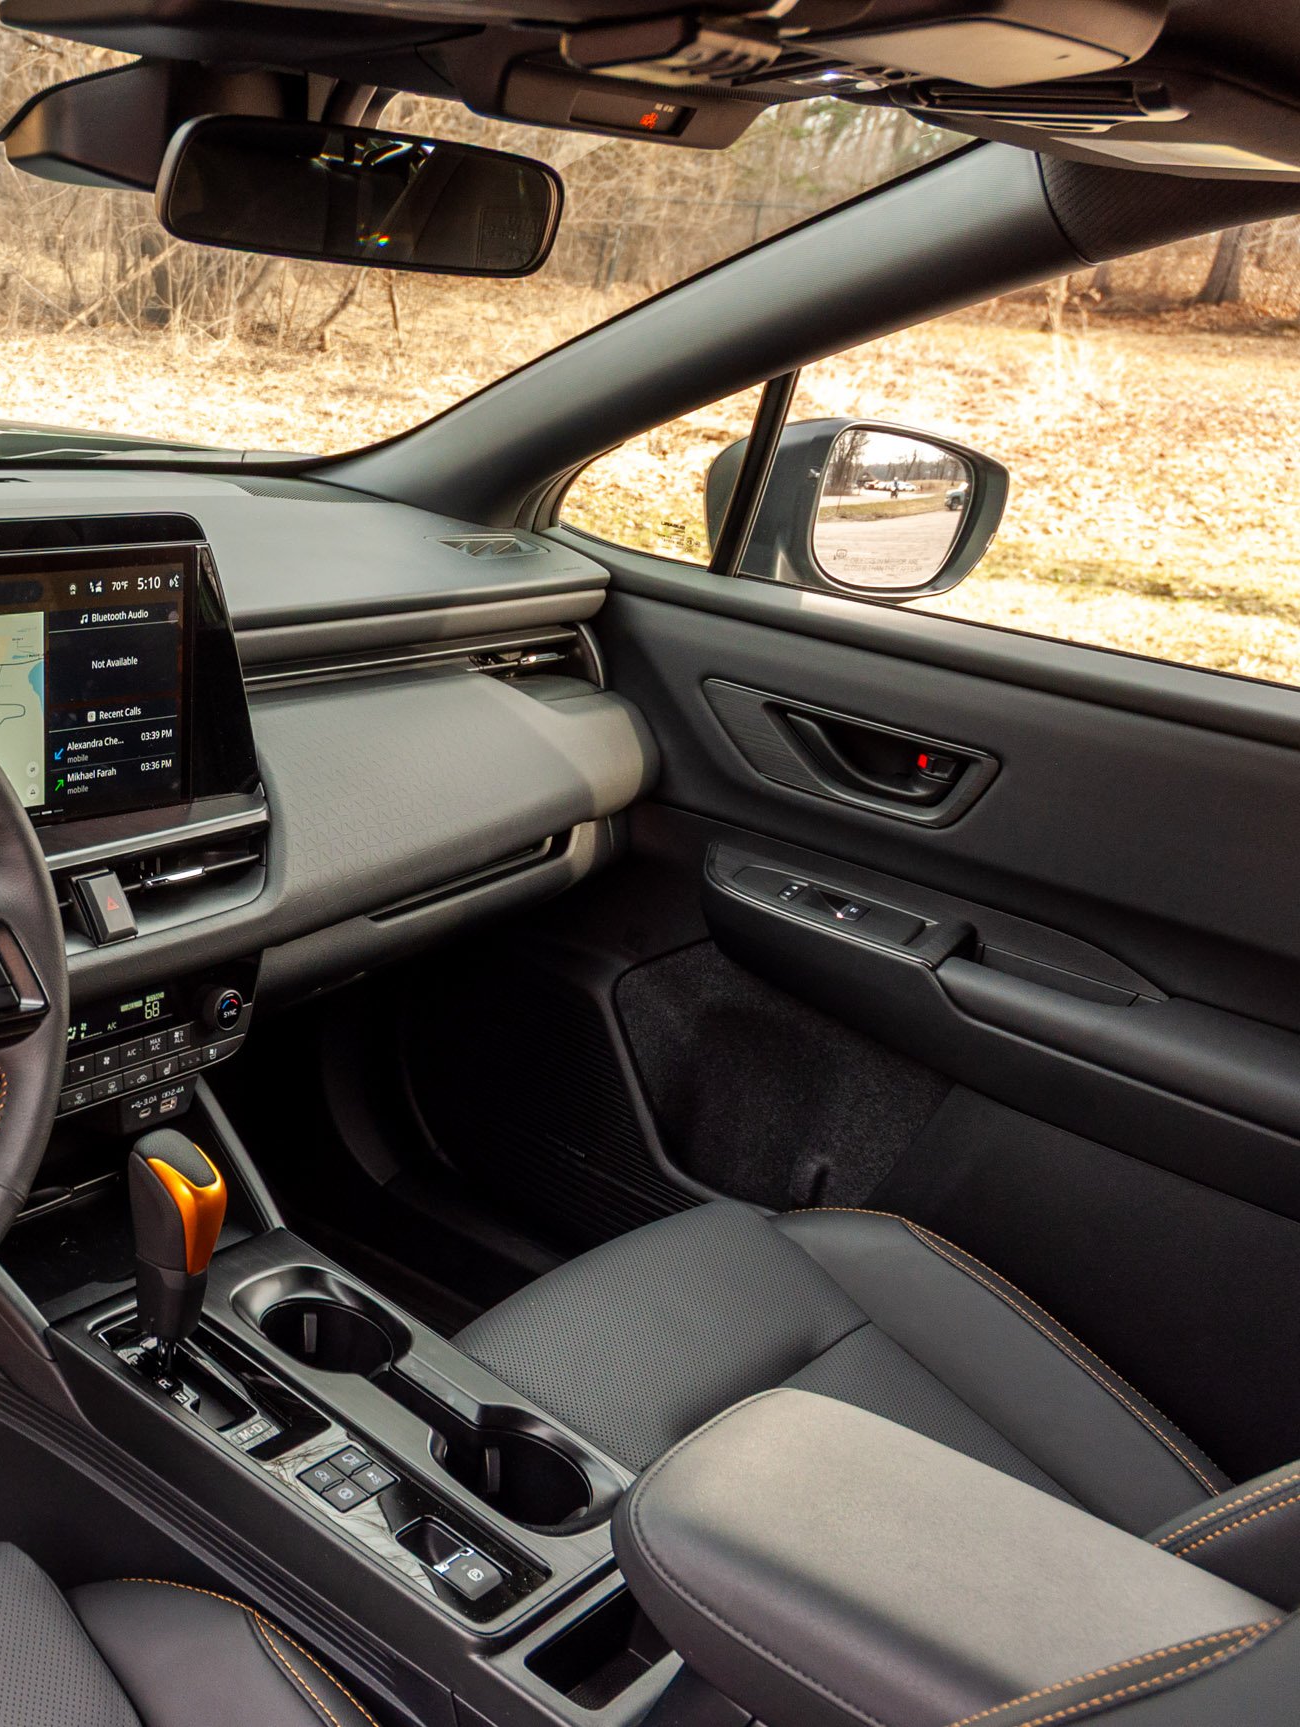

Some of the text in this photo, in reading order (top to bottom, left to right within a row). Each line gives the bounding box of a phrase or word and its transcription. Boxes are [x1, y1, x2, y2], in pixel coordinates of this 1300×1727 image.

[137, 576, 161, 590] 5:10
[92, 610, 148, 622] Bluetooth Audio
[92, 656, 138, 670] Not Available
[100, 706, 142, 720] Recent Calls
[140, 729, 172, 741] 03:39 PM
[66, 738, 102, 751] Alexandra
[67, 754, 88, 764] mobile
[140, 758, 172, 772] 03:36 PM
[67, 767, 116, 782] Mikhael Farah
[67, 785, 88, 795] mobile
[144, 1000, 160, 1020] 68
[223, 1008, 238, 1018] SYNC
[107, 1022, 117, 1031] A/C
[150, 1037, 161, 1046] MAX
[174, 1036, 184, 1044] ALL
[127, 1048, 136, 1057] A/C
[151, 1043, 160, 1052] A/C
[158, 1378, 172, 1390] R
[174, 1392, 188, 1404] N
